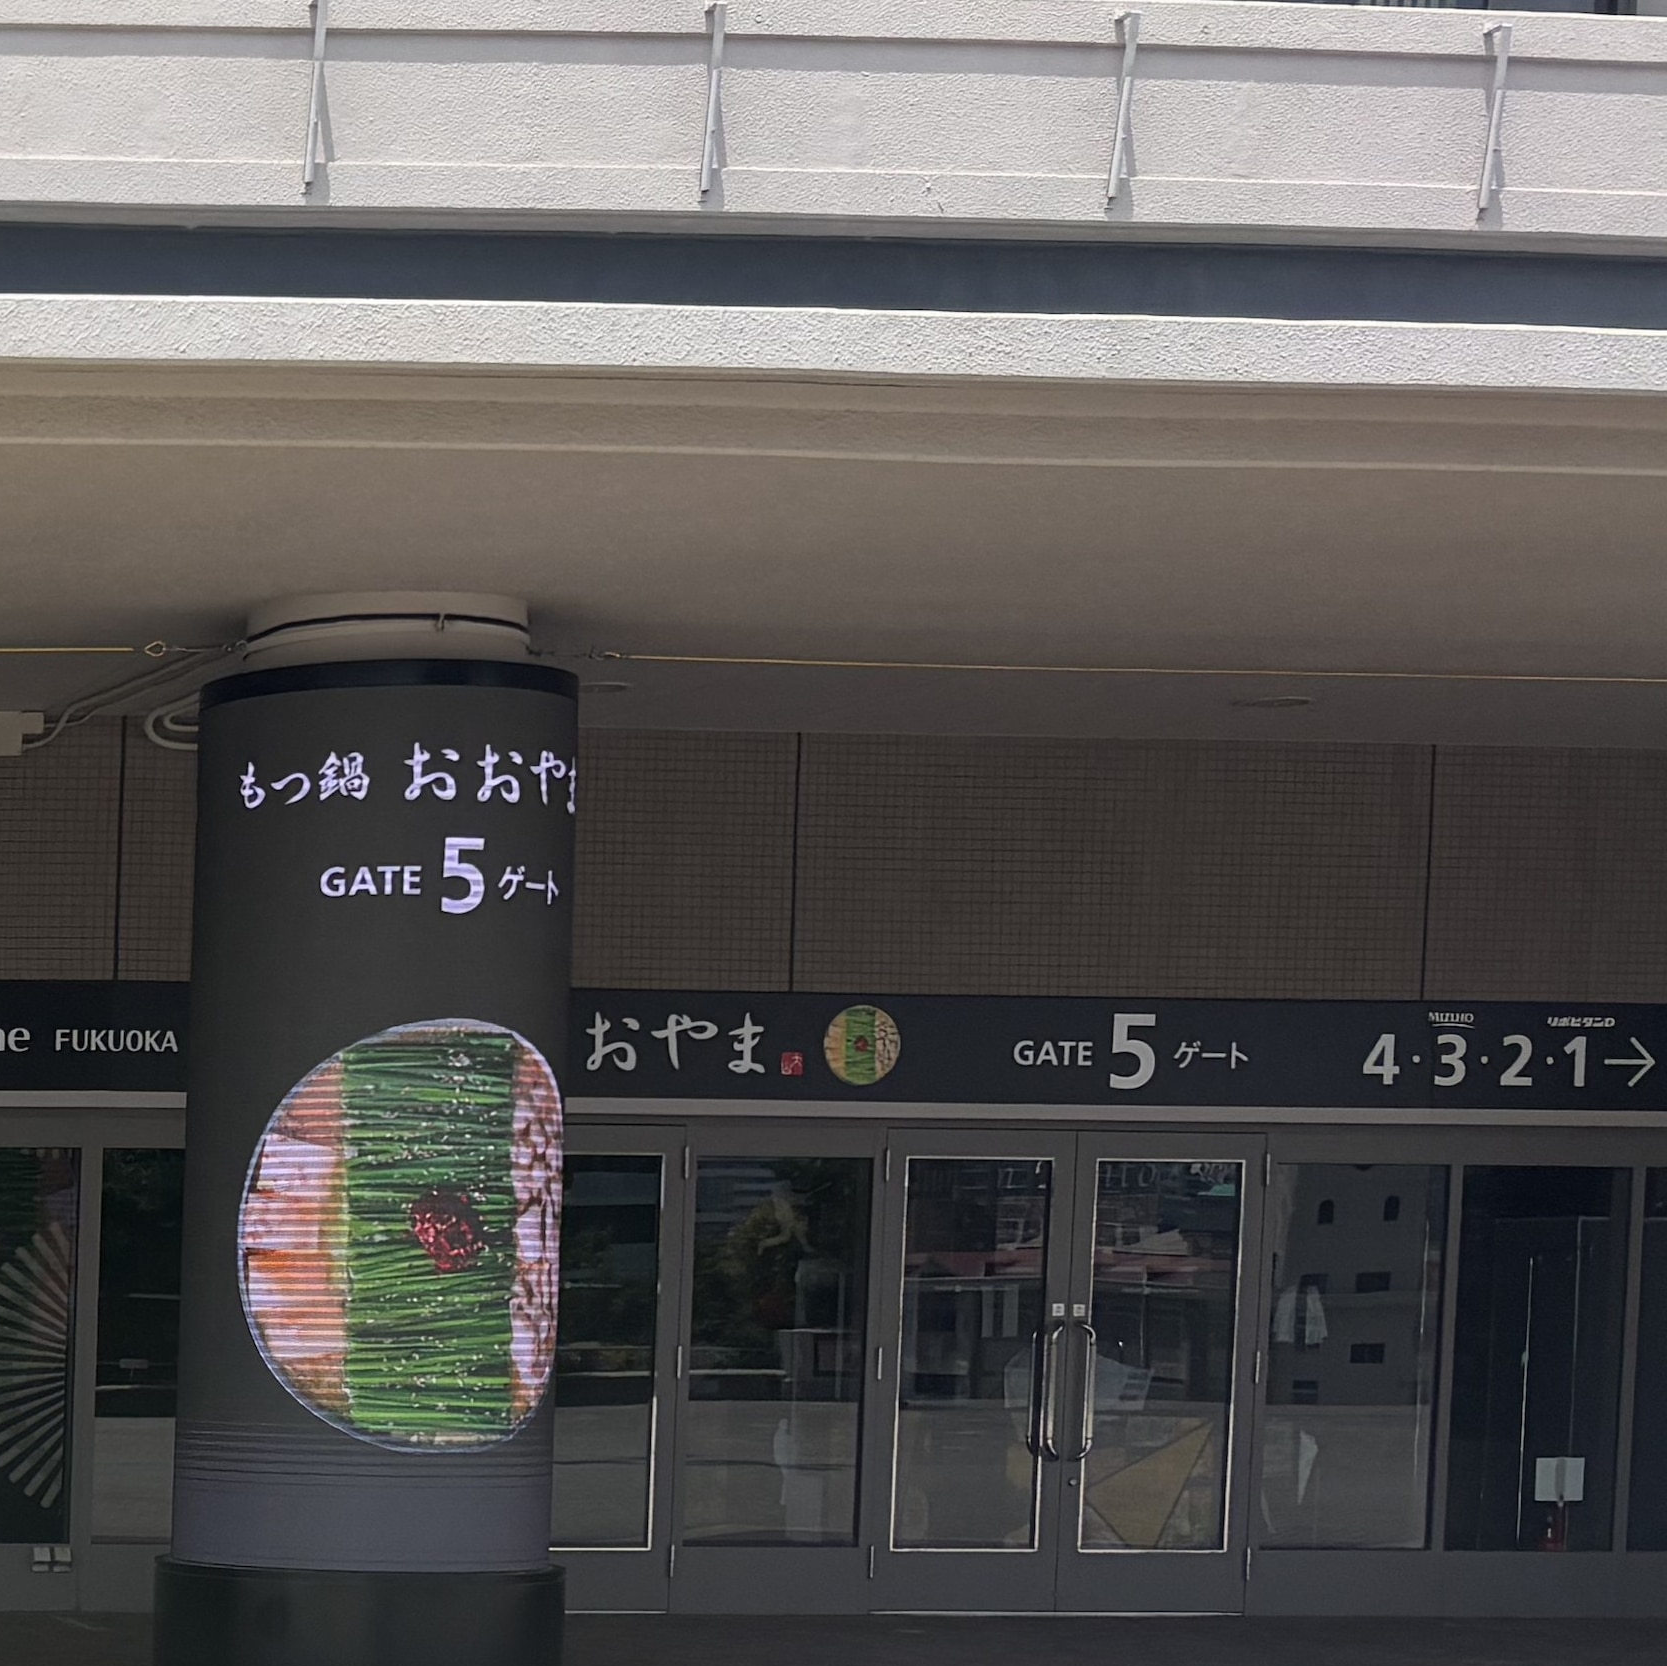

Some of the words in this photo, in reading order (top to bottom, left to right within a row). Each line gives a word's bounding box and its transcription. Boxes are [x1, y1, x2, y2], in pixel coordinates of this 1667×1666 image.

[240, 751, 370, 809] もつ鍋
[320, 865, 422, 897] GATE
[441, 837, 485, 914] 5
[498, 865, 559, 905] ゲート
[55, 1028, 178, 1053] FUKUOKA
[585, 1011, 766, 1074] おやま
[1013, 1040, 1093, 1067] GATE
[1109, 1013, 1156, 1090] 5
[1173, 1040, 1249, 1069] ゲート
